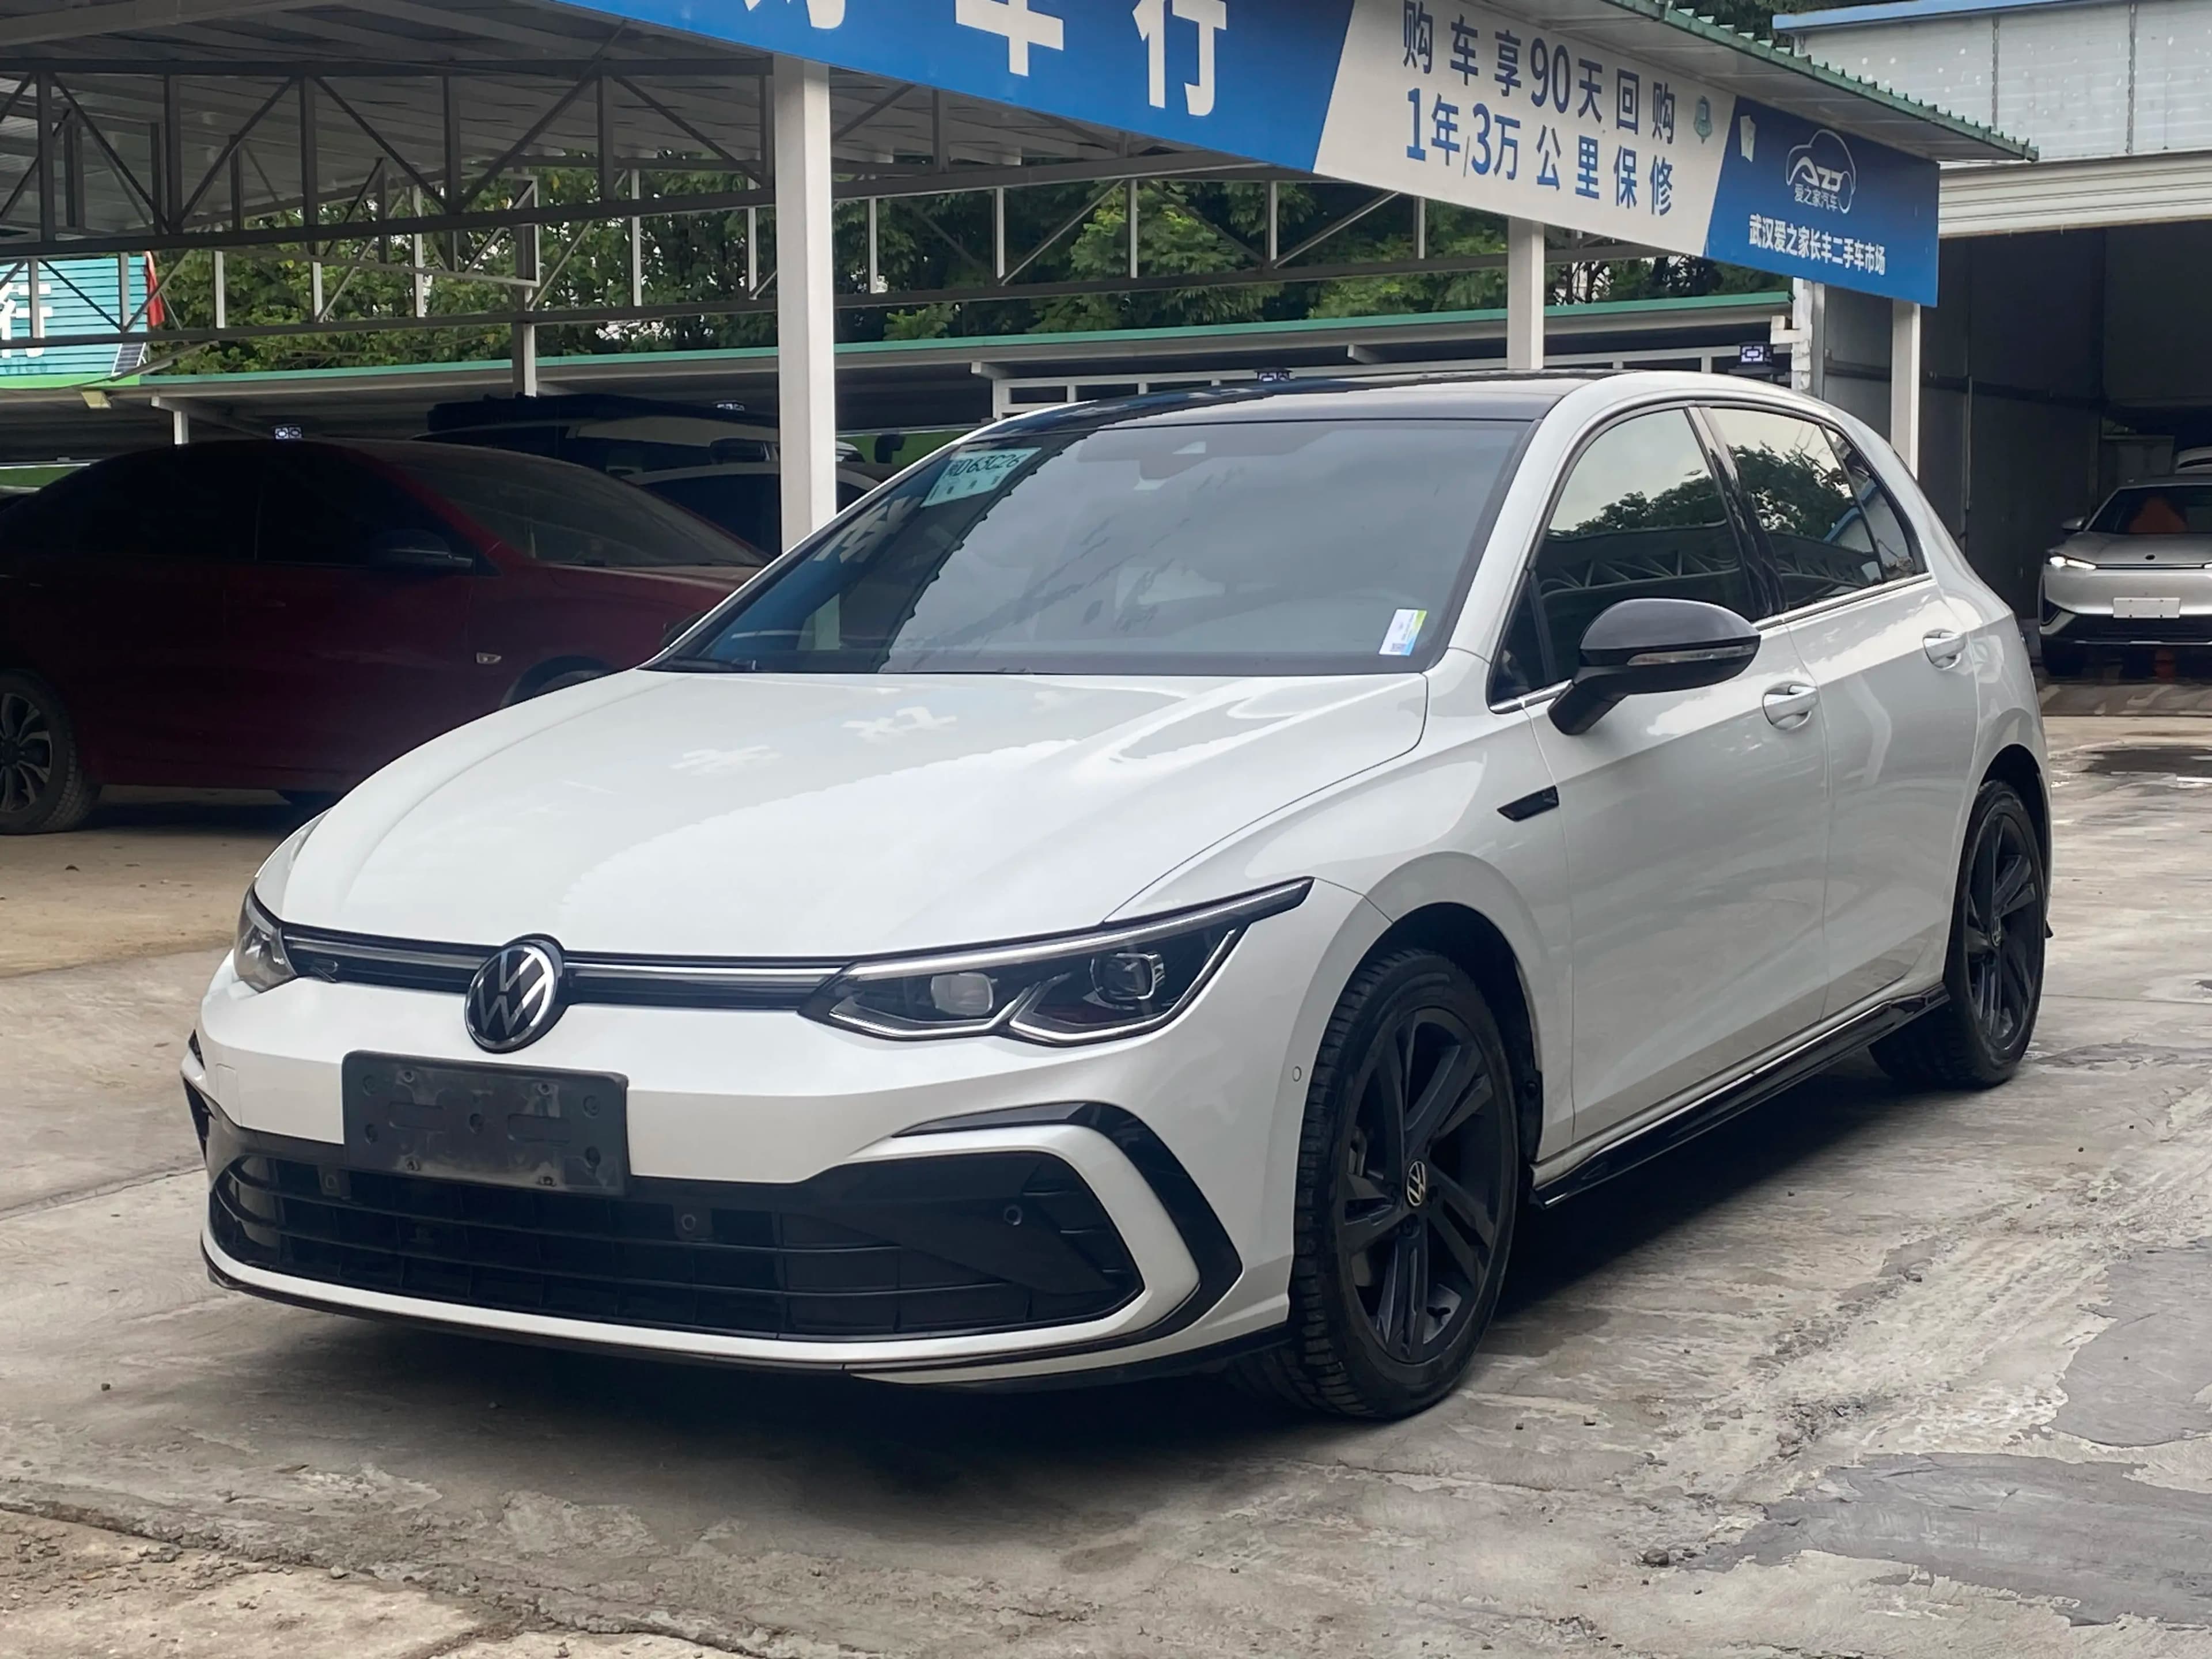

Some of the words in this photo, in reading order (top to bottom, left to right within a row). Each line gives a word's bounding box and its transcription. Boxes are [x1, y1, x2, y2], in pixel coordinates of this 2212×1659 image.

[1403, 1, 1675, 144] 购车享90天回购
[1794, 184, 1839, 212] 爱之家汽车
[1749, 213, 1885, 276] 武汉爱之家长丰二手车市场
